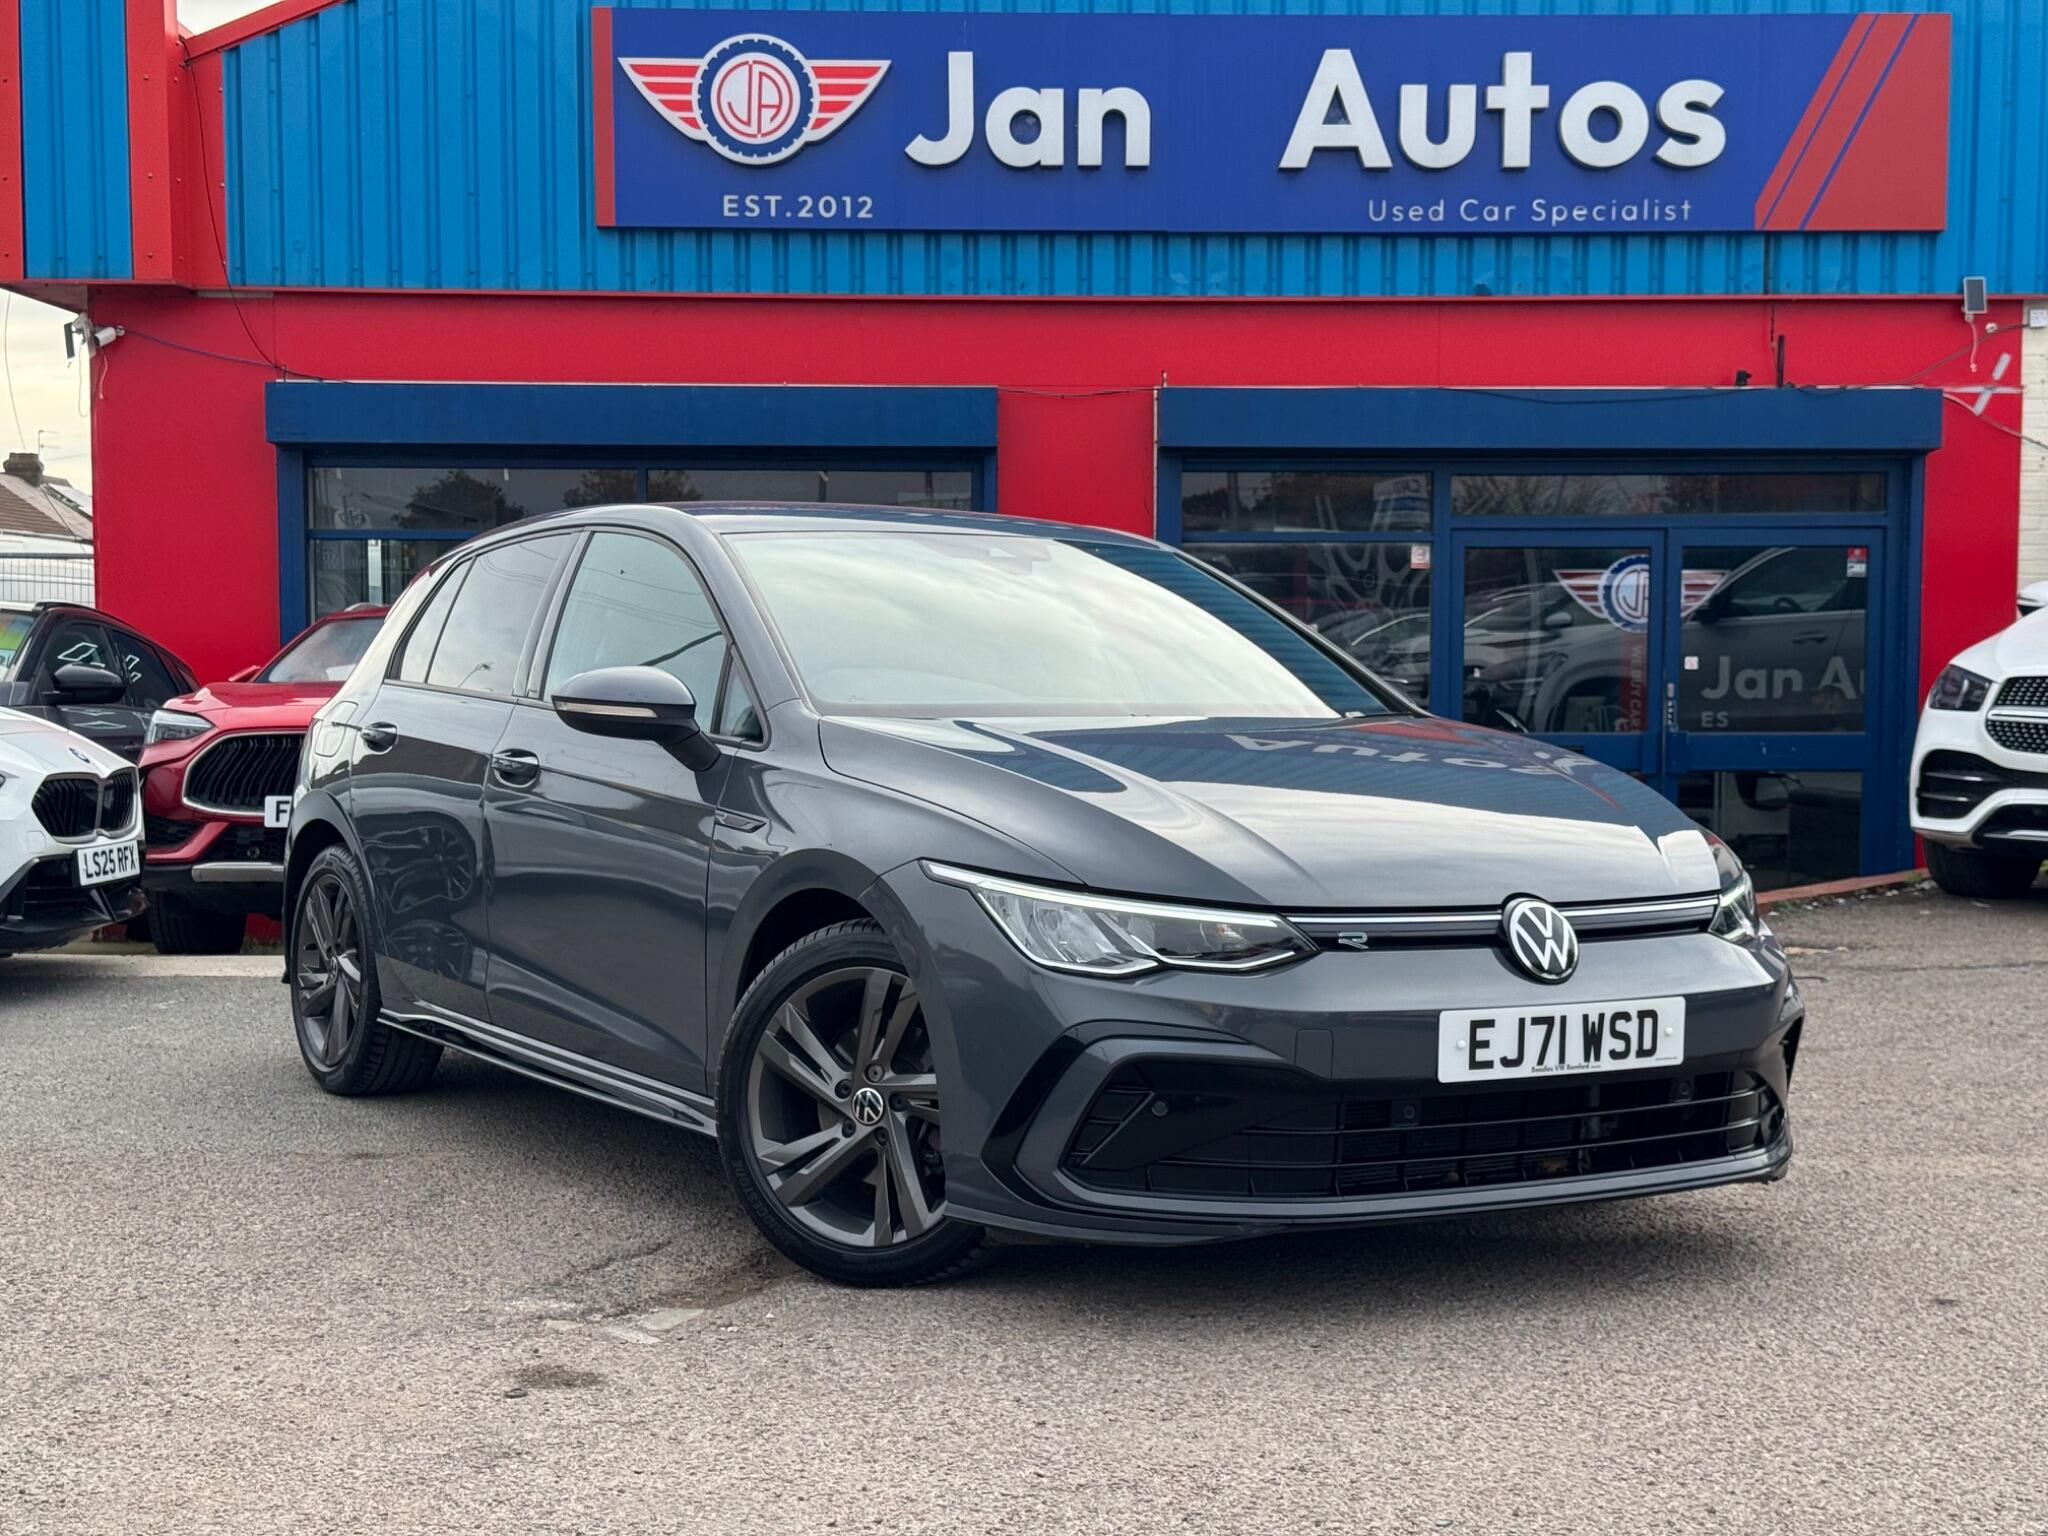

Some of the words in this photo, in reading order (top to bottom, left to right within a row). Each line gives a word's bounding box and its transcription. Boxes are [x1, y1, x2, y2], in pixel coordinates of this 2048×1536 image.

[905, 51, 1151, 167] Jan
[1279, 48, 1726, 169] Autos
[724, 195, 873, 218] EST.2012
[1368, 199, 1444, 222] Used
[1460, 199, 1516, 222] Car
[1531, 199, 1692, 226] Specialist
[1701, 656, 1803, 699] Jan
[1701, 711, 1729, 727] ES
[84, 848, 116, 879] LS25
[118, 844, 136, 873] RFX
[1469, 1015, 1567, 1070] EJ71
[1582, 1009, 1659, 1063] WSD
